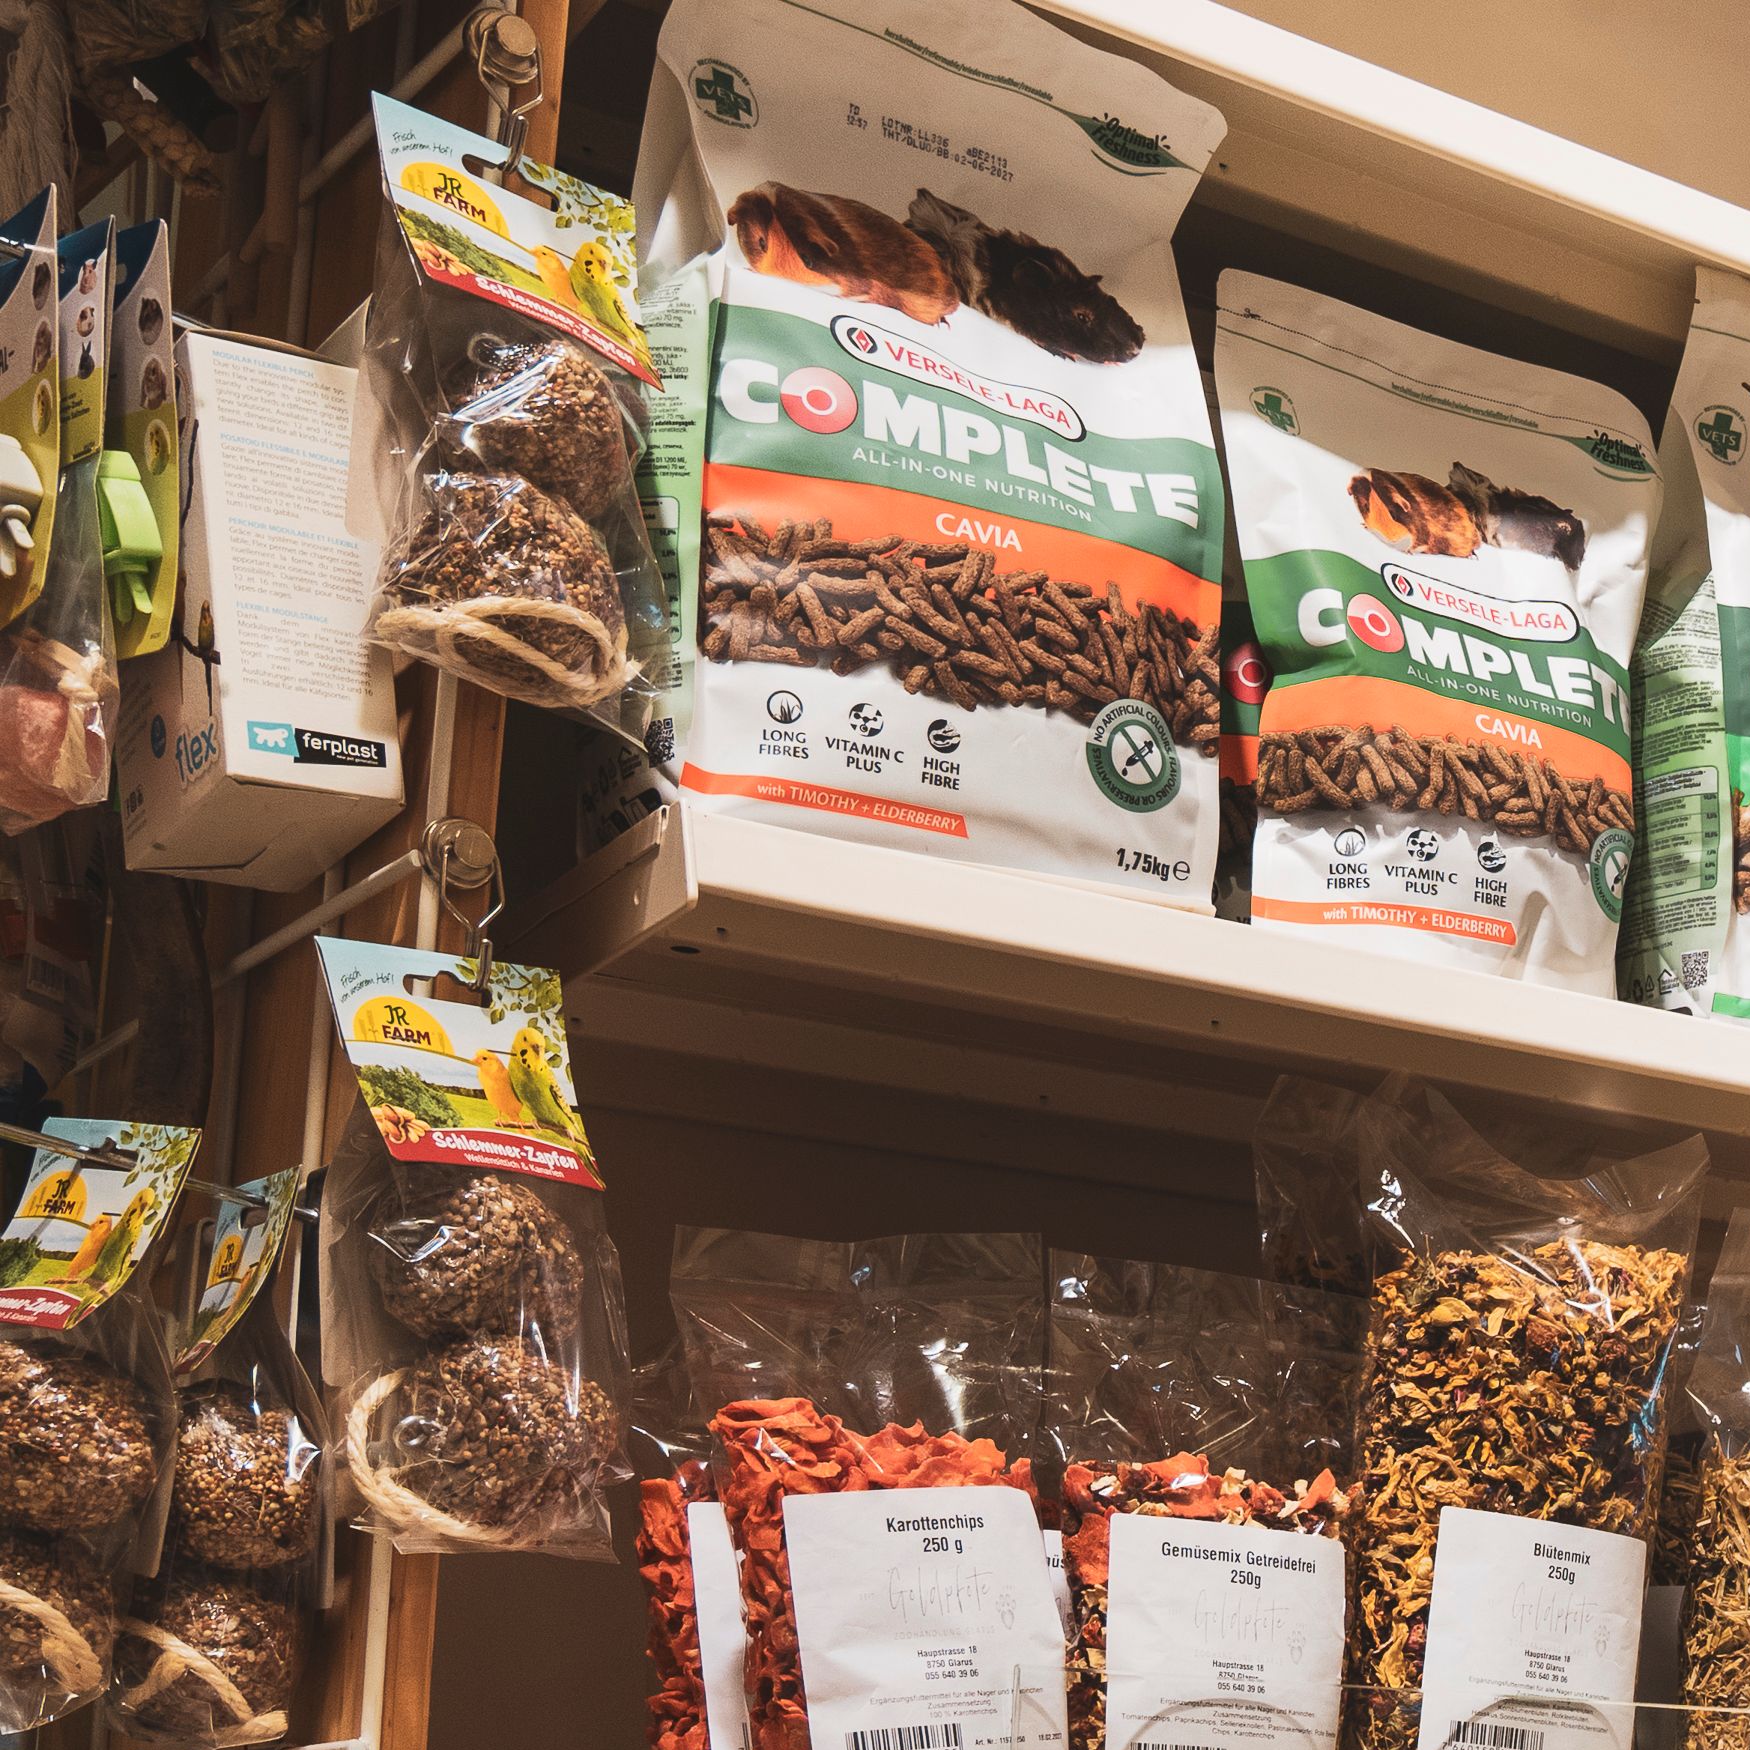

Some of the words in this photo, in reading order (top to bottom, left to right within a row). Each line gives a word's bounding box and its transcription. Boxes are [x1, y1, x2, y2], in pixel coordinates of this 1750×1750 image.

[1092, 126, 1161, 165] Freshness
[1105, 117, 1160, 150] Optimal
[438, 173, 464, 198] JR
[434, 187, 486, 222] FARM
[474, 276, 636, 367] Schlemmer-Zapfen
[885, 341, 1072, 429] VERSELE-LAGA
[720, 358, 1199, 530] COMPLETE
[1600, 432, 1640, 459] Optimal
[1698, 429, 1738, 448] VETS
[1591, 442, 1647, 472] Freshness
[852, 447, 976, 487] ALL-IN-ONE
[985, 479, 1092, 522] NUTRITION
[935, 514, 1023, 552] CAVIA
[1406, 664, 1500, 702] ALL-IN-ONE
[1507, 694, 1593, 729] NUTRITION
[762, 728, 807, 745] LONG
[1475, 714, 1543, 750] CAVIA
[173, 716, 219, 782] flex
[302, 733, 378, 760] ferplast
[758, 743, 810, 760] FIBRES
[824, 736, 886, 757] VITAMIN
[888, 748, 905, 764] C
[846, 756, 882, 774] PLUS
[922, 756, 961, 775] HIGH
[921, 771, 961, 791] FIBRE
[1329, 863, 1368, 876] LONG
[1326, 876, 1370, 890] FIBRES
[1405, 881, 1438, 896] PLUS
[1475, 876, 1507, 893] HIGH
[1474, 891, 1507, 908] FIBRE
[382, 1004, 411, 1028] JR
[381, 1022, 431, 1047] FARM
[431, 1130, 580, 1172] Schlemmer-Zapfen
[52, 1177, 72, 1201] JR
[42, 1198, 75, 1217] FARM
[886, 1514, 984, 1533] Karottenchips
[922, 1536, 949, 1552] 250
[955, 1538, 963, 1553] g
[1533, 1542, 1591, 1566] Blütenmix
[1161, 1542, 1241, 1564] Gemüsemix
[1246, 1551, 1316, 1574] Getreidefrei
[1230, 1569, 1262, 1589] 250g
[1548, 1565, 1576, 1585] 250g
[917, 1647, 966, 1658] Haupstrasse
[968, 1646, 977, 1655] 18
[1524, 1650, 1562, 1663] Haupstrasse
[1564, 1655, 1571, 1663] 18
[925, 1671, 940, 1680] 055
[942, 1670, 956, 1679] 640
[959, 1670, 968, 1678] 39
[970, 1669, 979, 1677] 06
